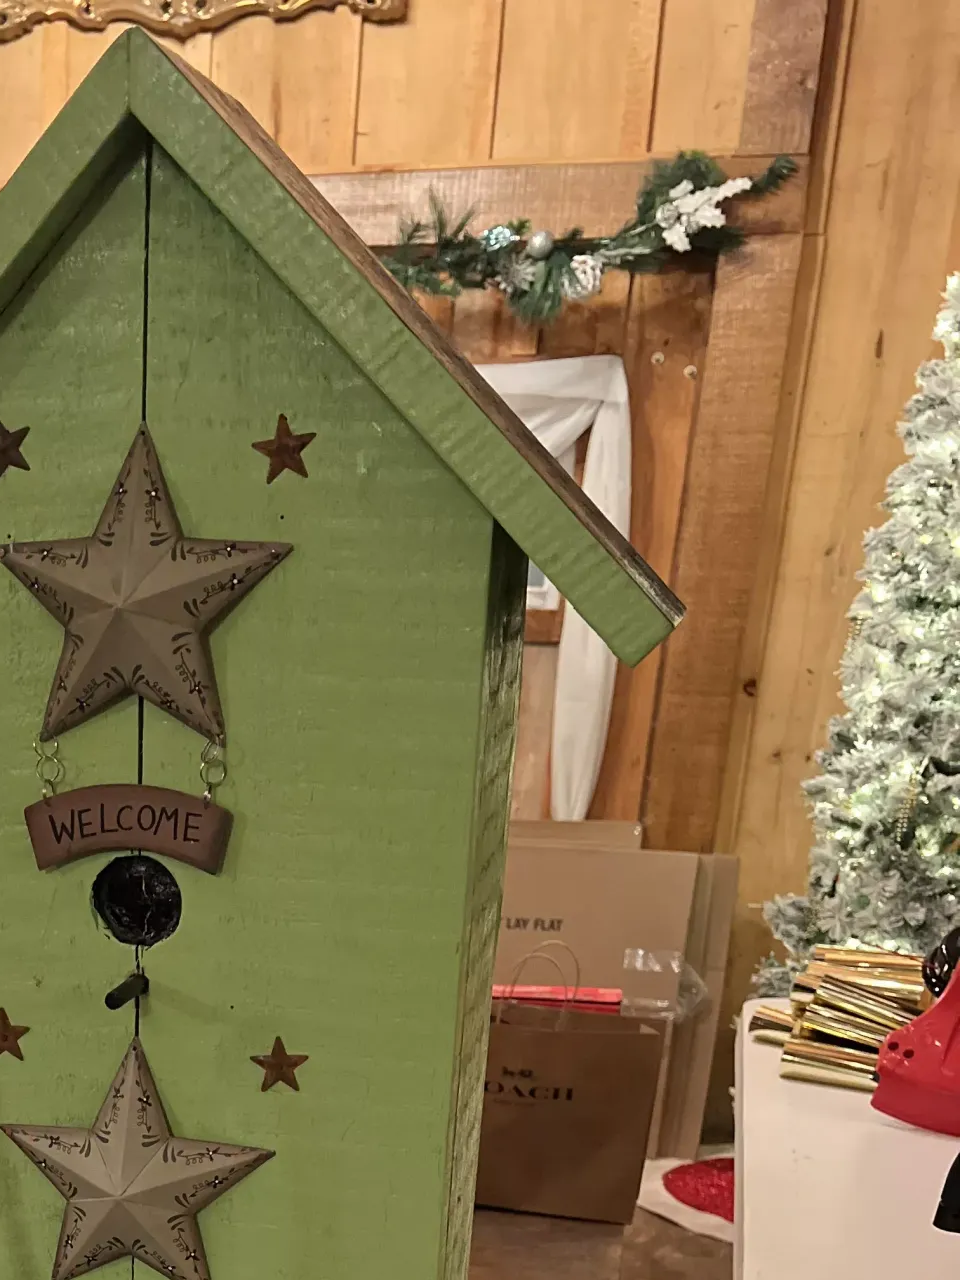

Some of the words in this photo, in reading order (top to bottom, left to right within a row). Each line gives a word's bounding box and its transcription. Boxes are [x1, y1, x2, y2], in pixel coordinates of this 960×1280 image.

[48, 803, 203, 845] WELCOME
[505, 917, 530, 931] LAY
[533, 917, 564, 932] FLAT
[484, 1081, 573, 1101] OACH
